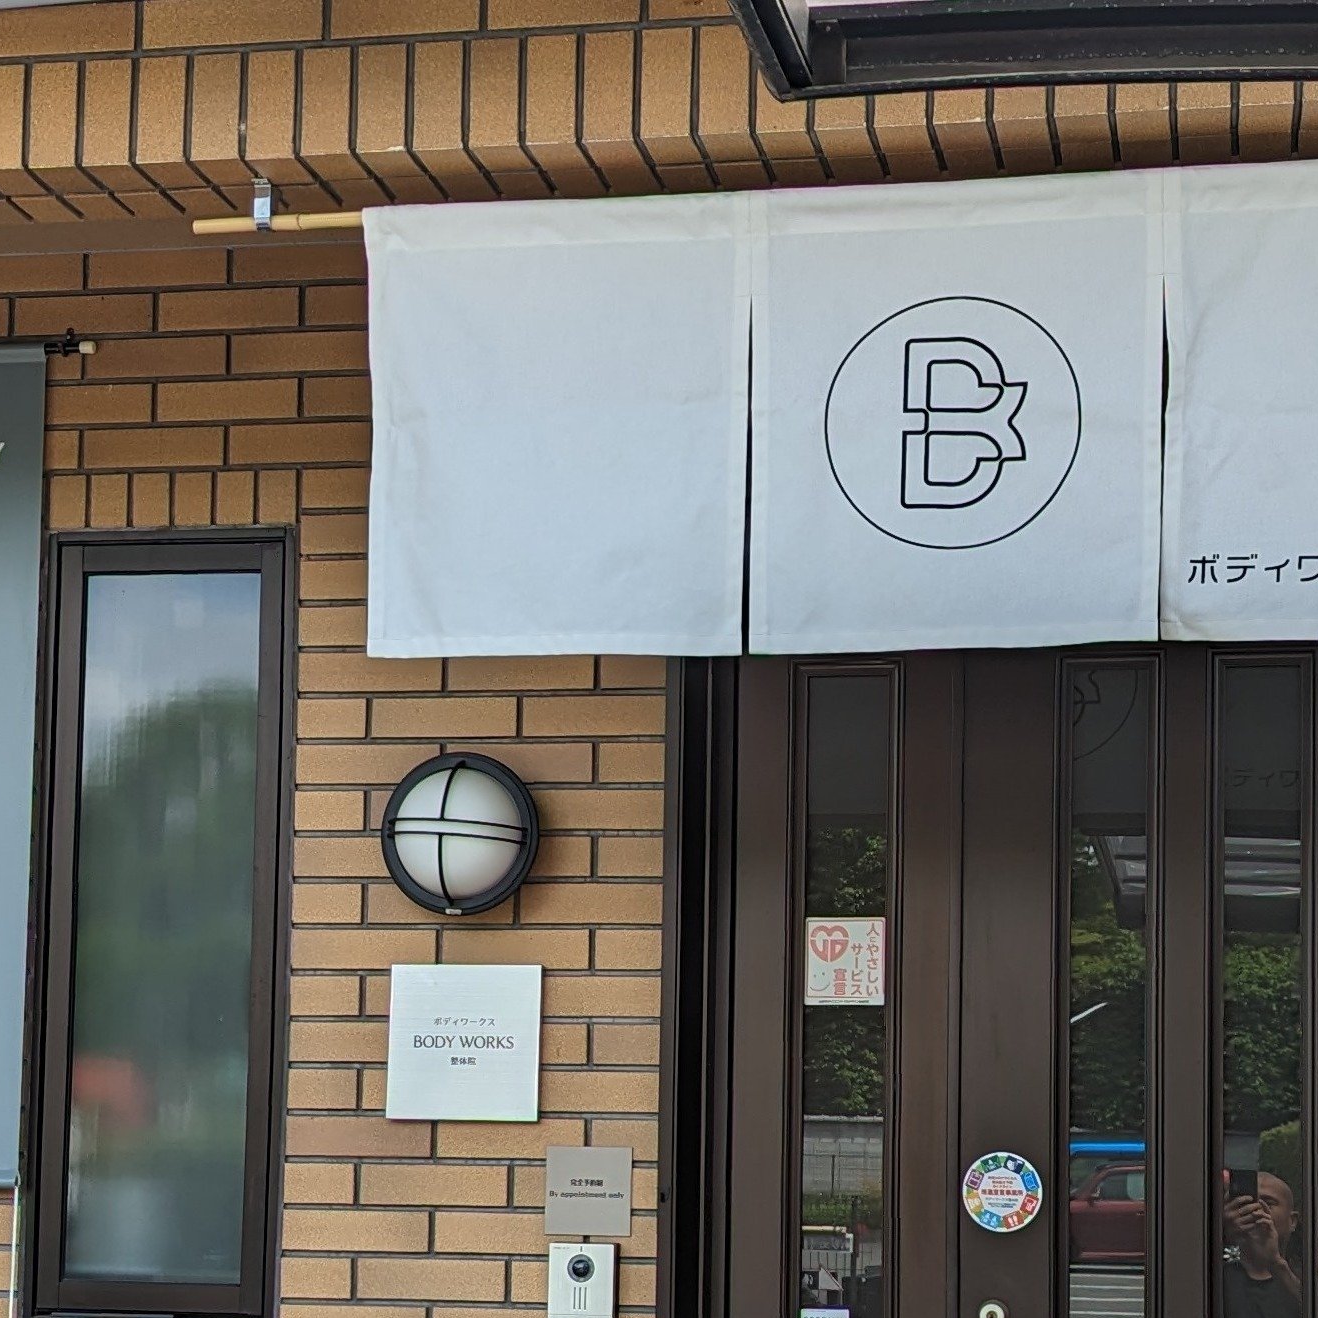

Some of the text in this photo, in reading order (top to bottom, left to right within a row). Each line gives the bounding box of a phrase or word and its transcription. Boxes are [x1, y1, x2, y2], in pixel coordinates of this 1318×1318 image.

[851, 942, 863, 996] サービス
[866, 922, 880, 996] 人にやさしい
[434, 1016, 496, 1027] ボディワークス
[413, 1034, 515, 1049] BODY WORKS
